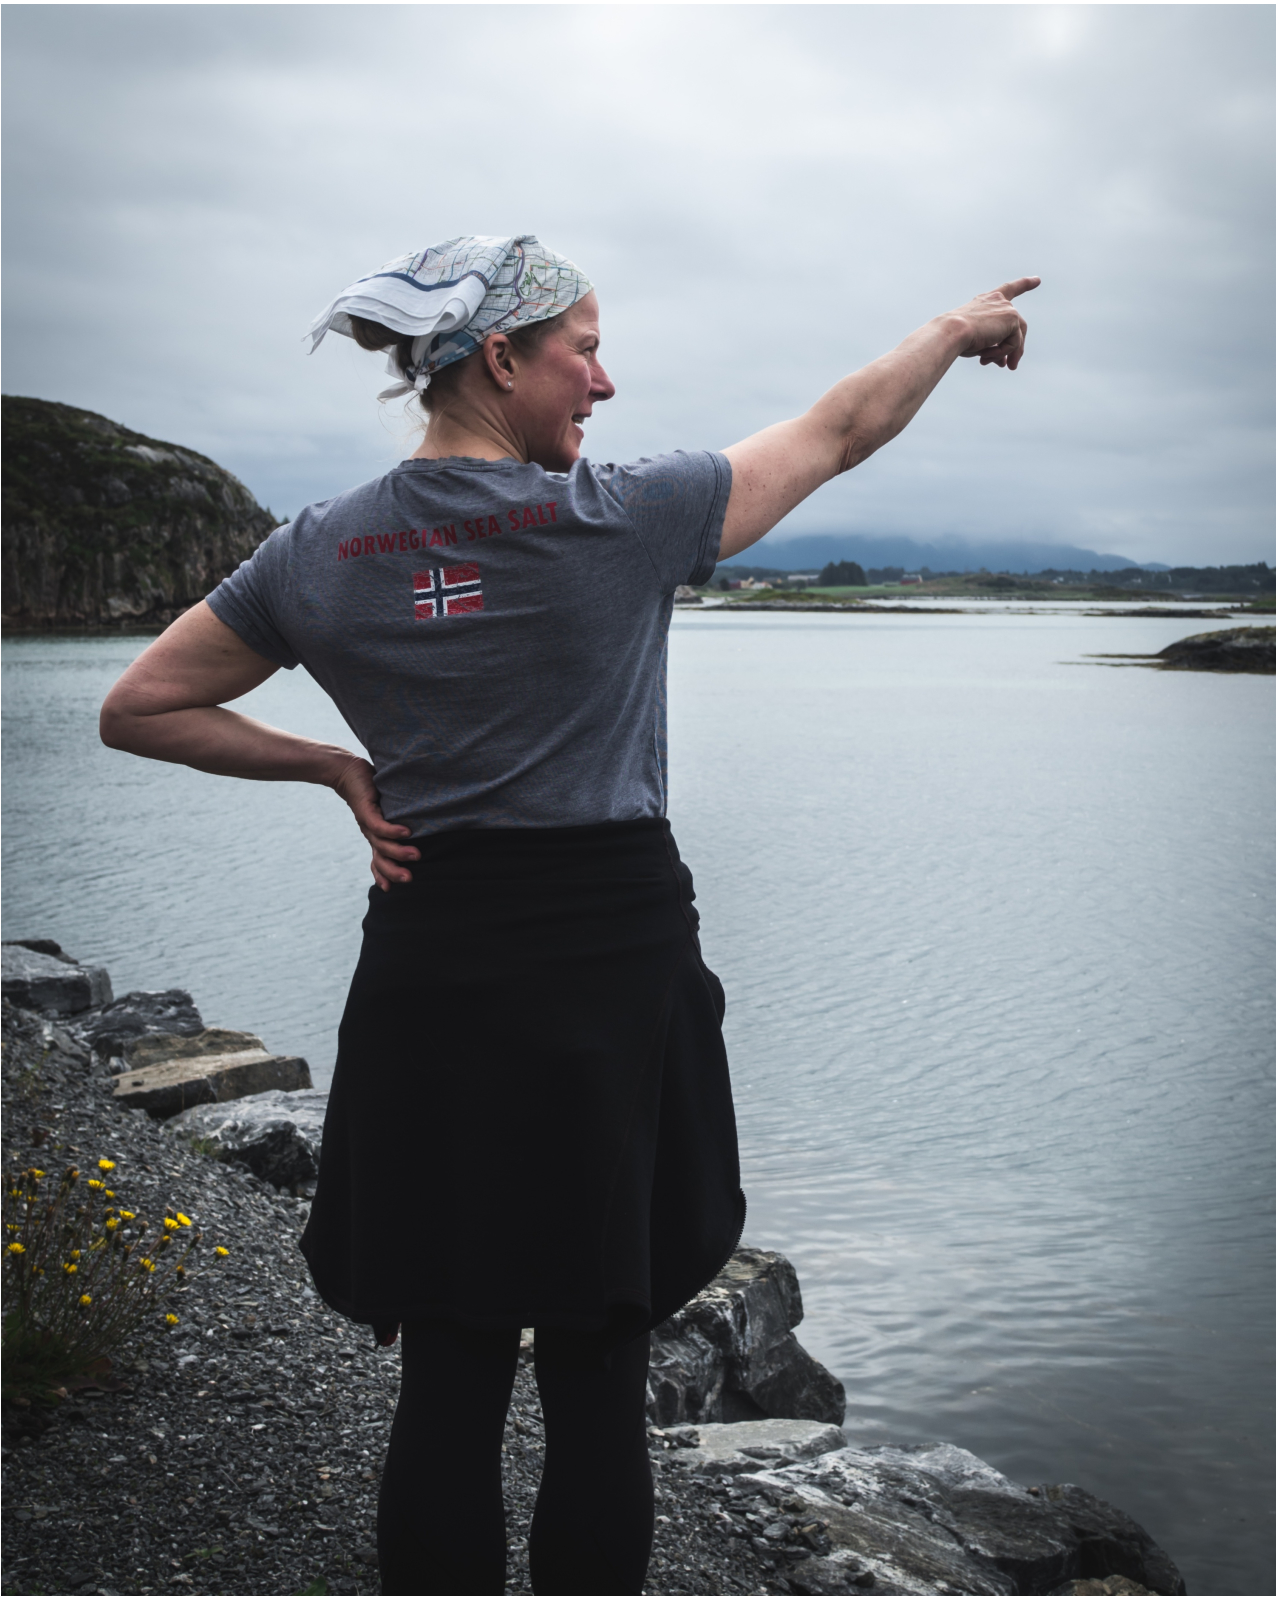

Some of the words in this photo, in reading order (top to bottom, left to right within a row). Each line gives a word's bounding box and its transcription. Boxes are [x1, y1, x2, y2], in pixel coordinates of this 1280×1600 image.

[337, 523, 458, 561] NORWEGIAN
[463, 514, 502, 541] SEA
[507, 501, 558, 531] SALT
